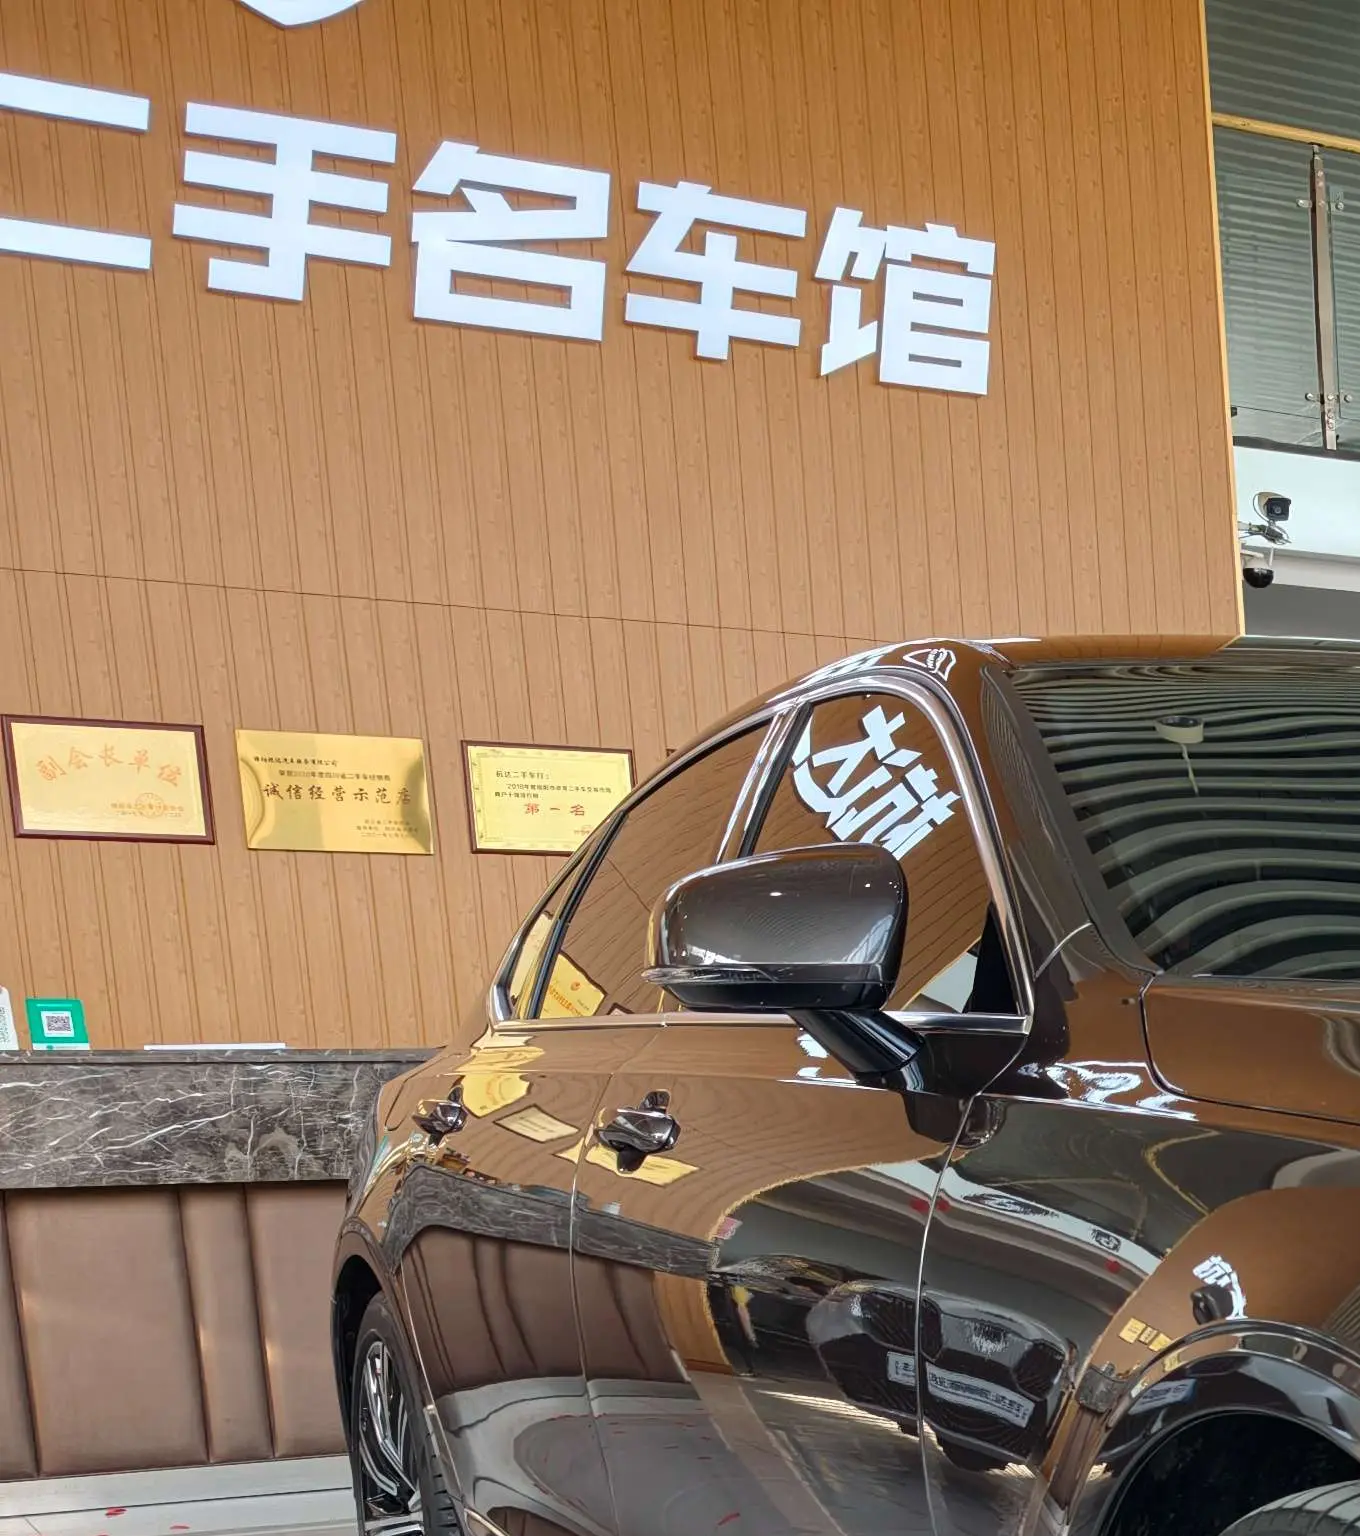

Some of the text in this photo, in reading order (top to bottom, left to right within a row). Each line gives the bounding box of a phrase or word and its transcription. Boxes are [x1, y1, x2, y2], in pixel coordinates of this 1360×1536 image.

[0, 73, 996, 396] 二手名车馆
[35, 743, 183, 787] 副会长单位
[263, 784, 412, 805] 诚信经营示范店
[524, 802, 586, 816] 第一名
